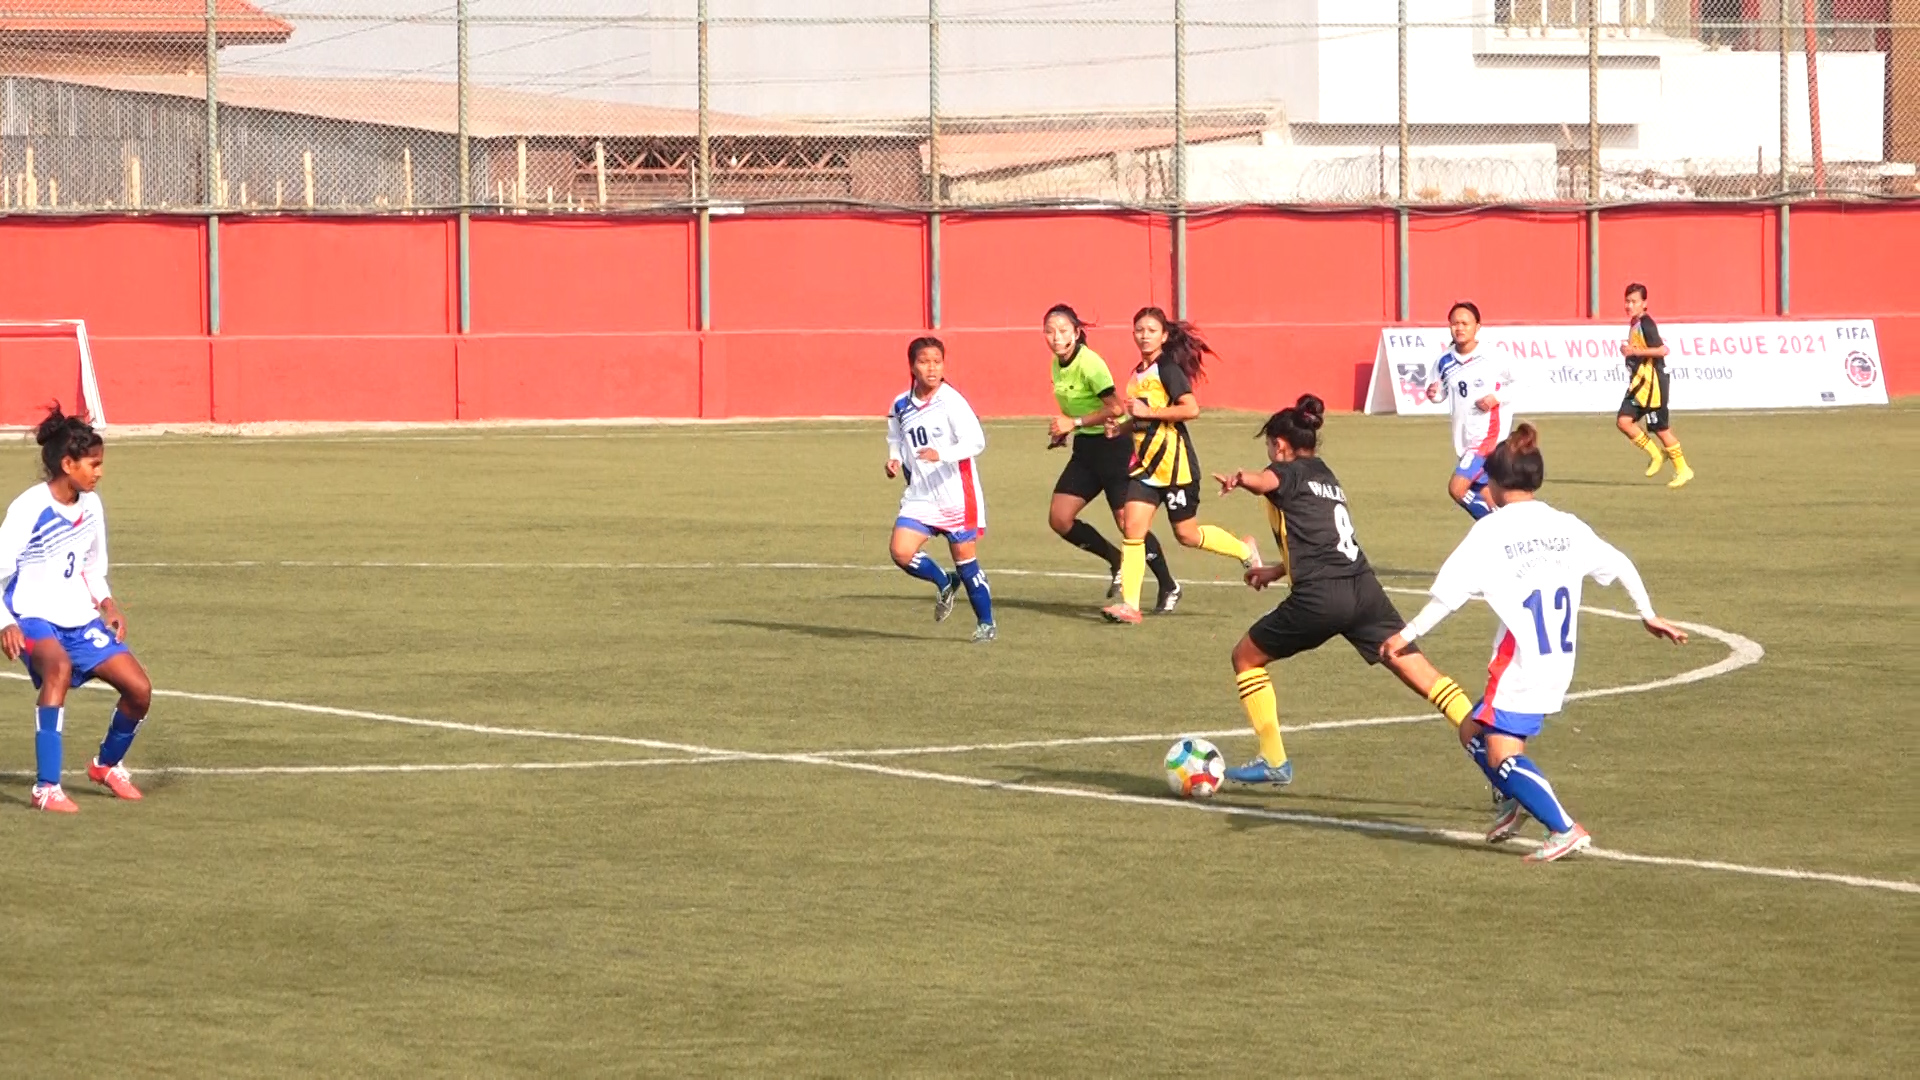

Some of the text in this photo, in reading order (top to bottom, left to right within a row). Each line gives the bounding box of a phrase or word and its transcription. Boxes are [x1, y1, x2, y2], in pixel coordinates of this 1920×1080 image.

[1389, 335, 1426, 348] FIFA
[1836, 326, 1870, 340] FIFA
[1679, 335, 1768, 356] LEAGUE
[1777, 334, 1827, 354] 2021
[1457, 380, 1468, 398] 8
[908, 425, 928, 448] 10
[1166, 489, 1187, 510] 24
[1333, 502, 1359, 562] 8
[63, 551, 76, 579] 3
[1522, 585, 1574, 656] 12
[83, 627, 110, 649] 3
